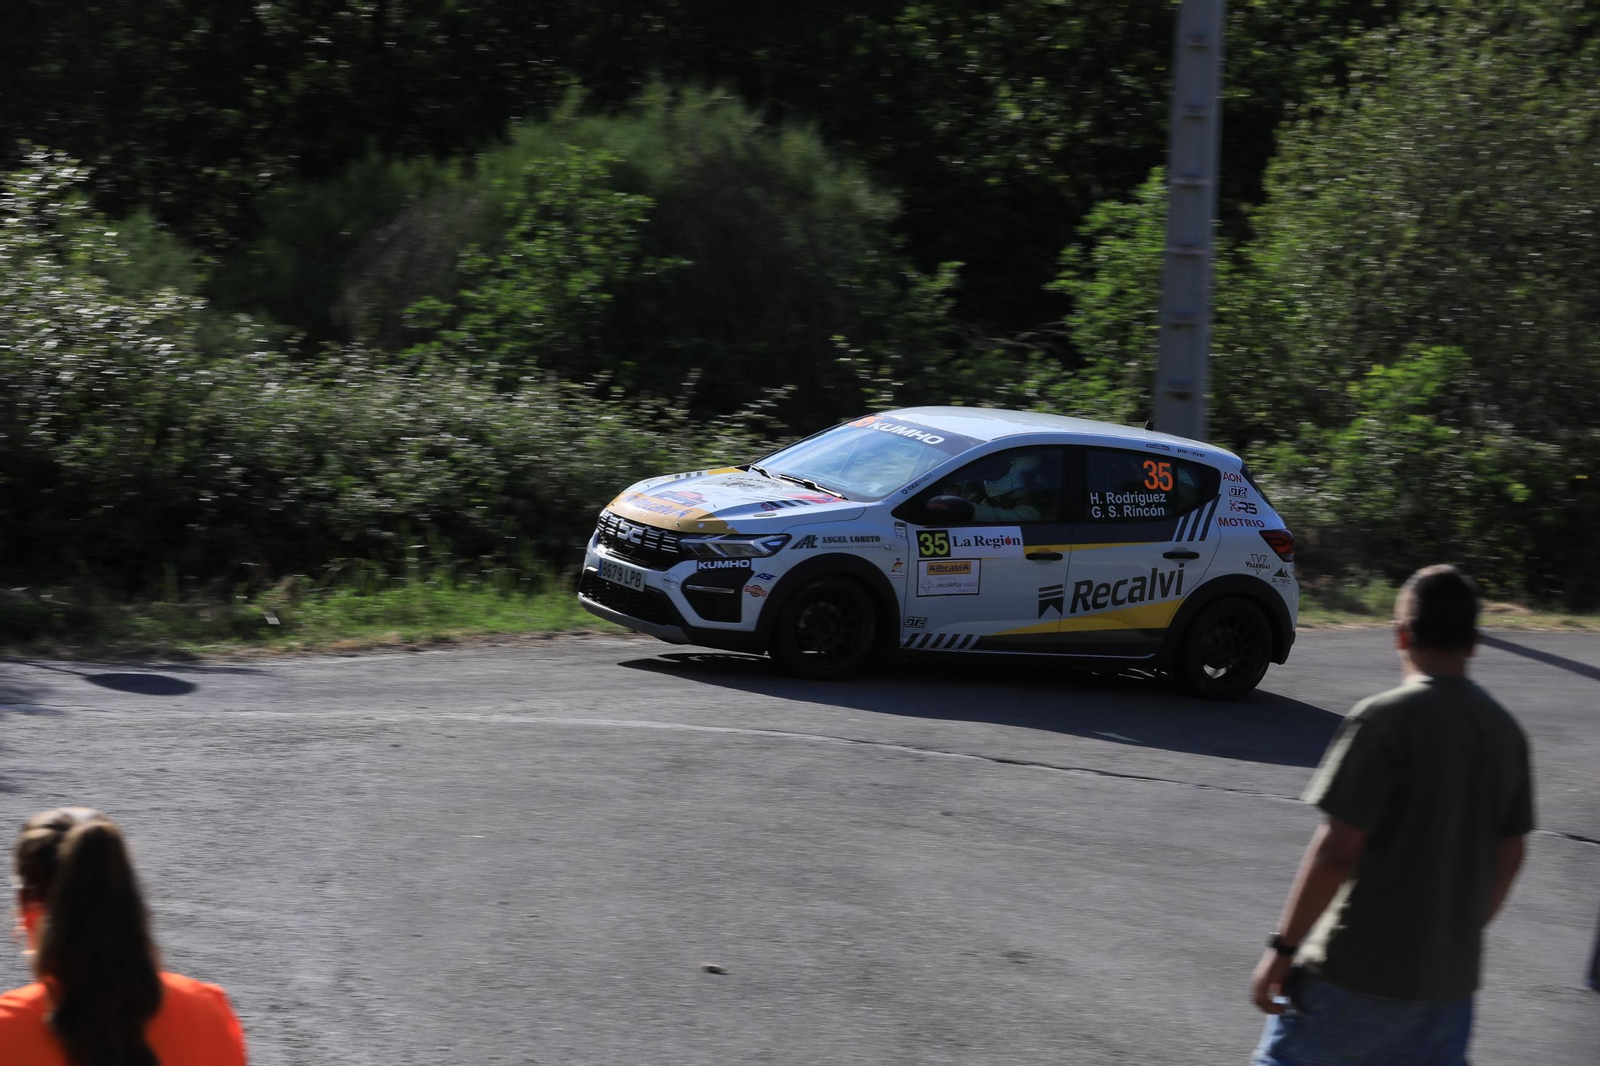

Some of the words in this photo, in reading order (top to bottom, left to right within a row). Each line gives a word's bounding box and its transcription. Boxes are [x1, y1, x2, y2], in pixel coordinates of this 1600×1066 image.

[867, 421, 945, 445] KUMHO
[1143, 460, 1173, 492] 35
[1222, 471, 1243, 483] AON
[1089, 492, 1103, 505] H.
[1105, 491, 1167, 506] Rodríguez
[1091, 507, 1105, 519] G.
[1108, 506, 1121, 518] S.
[1123, 504, 1165, 518] Rincón
[1217, 517, 1266, 529] MOTRIO
[919, 532, 949, 556] 35
[952, 534, 972, 549] La
[698, 560, 750, 570] KUMHO
[602, 561, 624, 582] 8679
[625, 568, 643, 588] LPB
[1069, 563, 1185, 615] Recalvi
